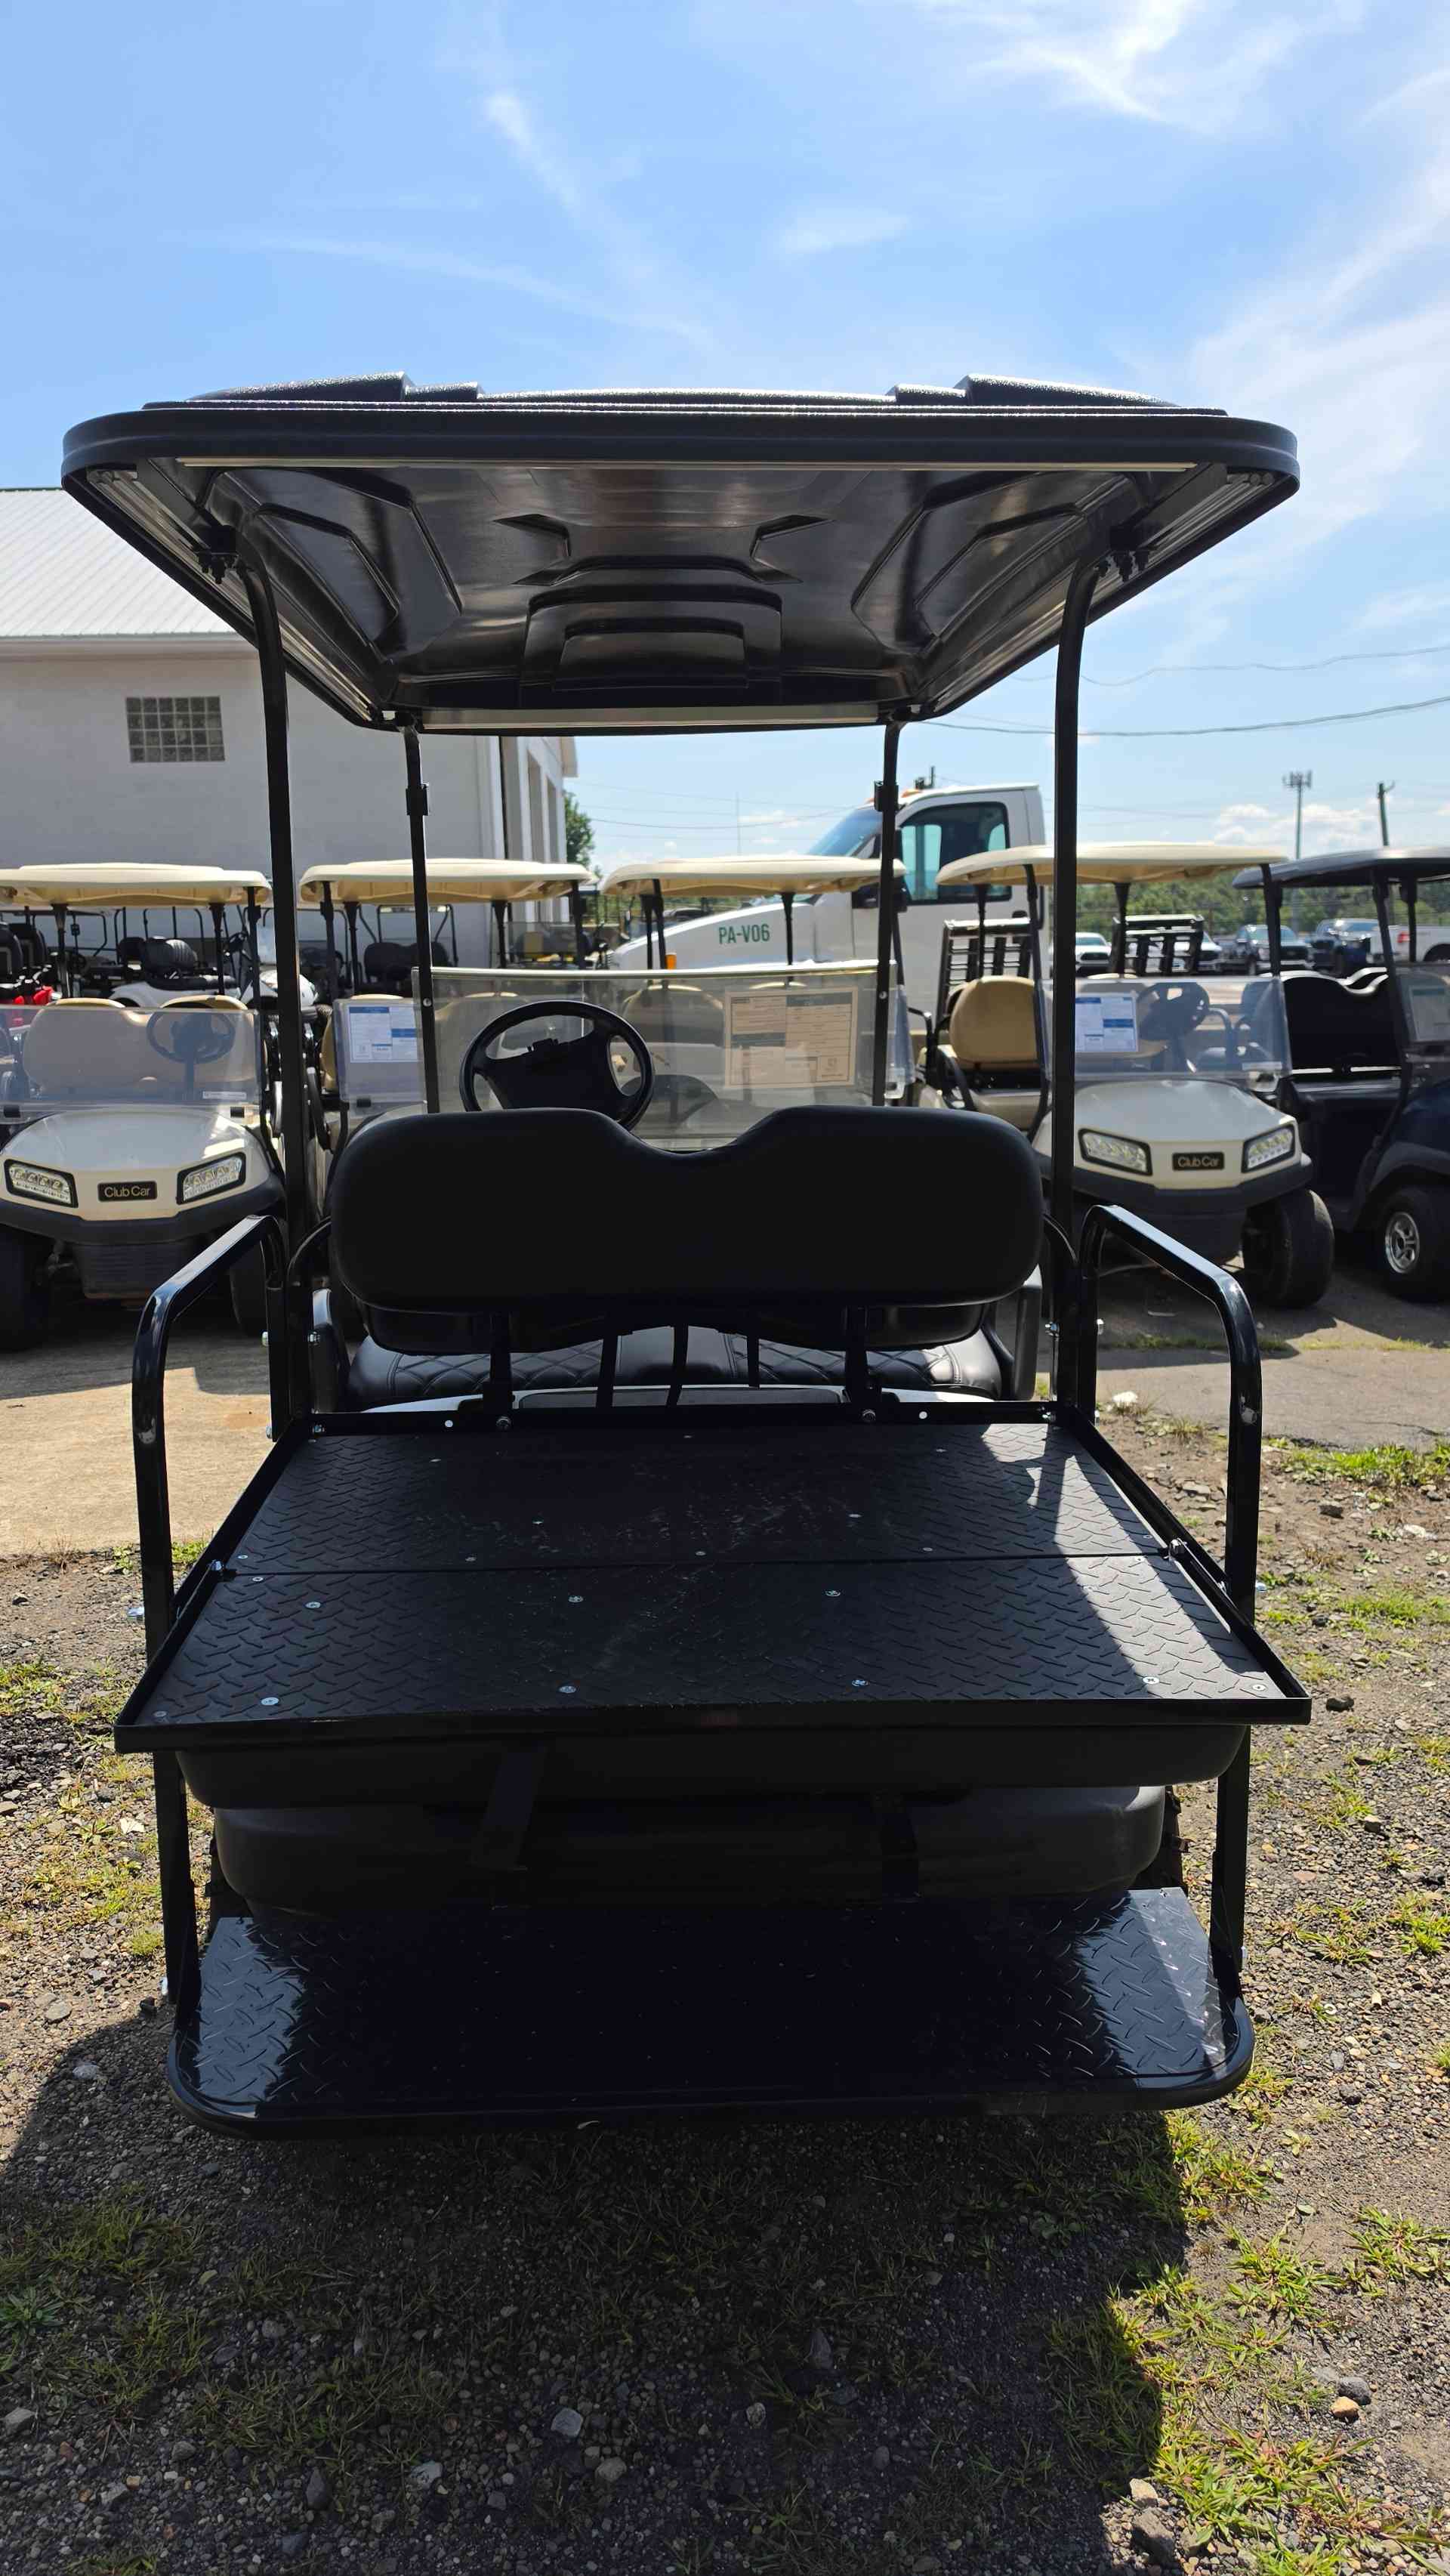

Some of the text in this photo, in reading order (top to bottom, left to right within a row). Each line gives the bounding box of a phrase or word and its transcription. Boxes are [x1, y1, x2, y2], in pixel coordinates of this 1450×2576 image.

[718, 923, 770, 944] PA-V06
[104, 1185, 150, 1197] Club Car
